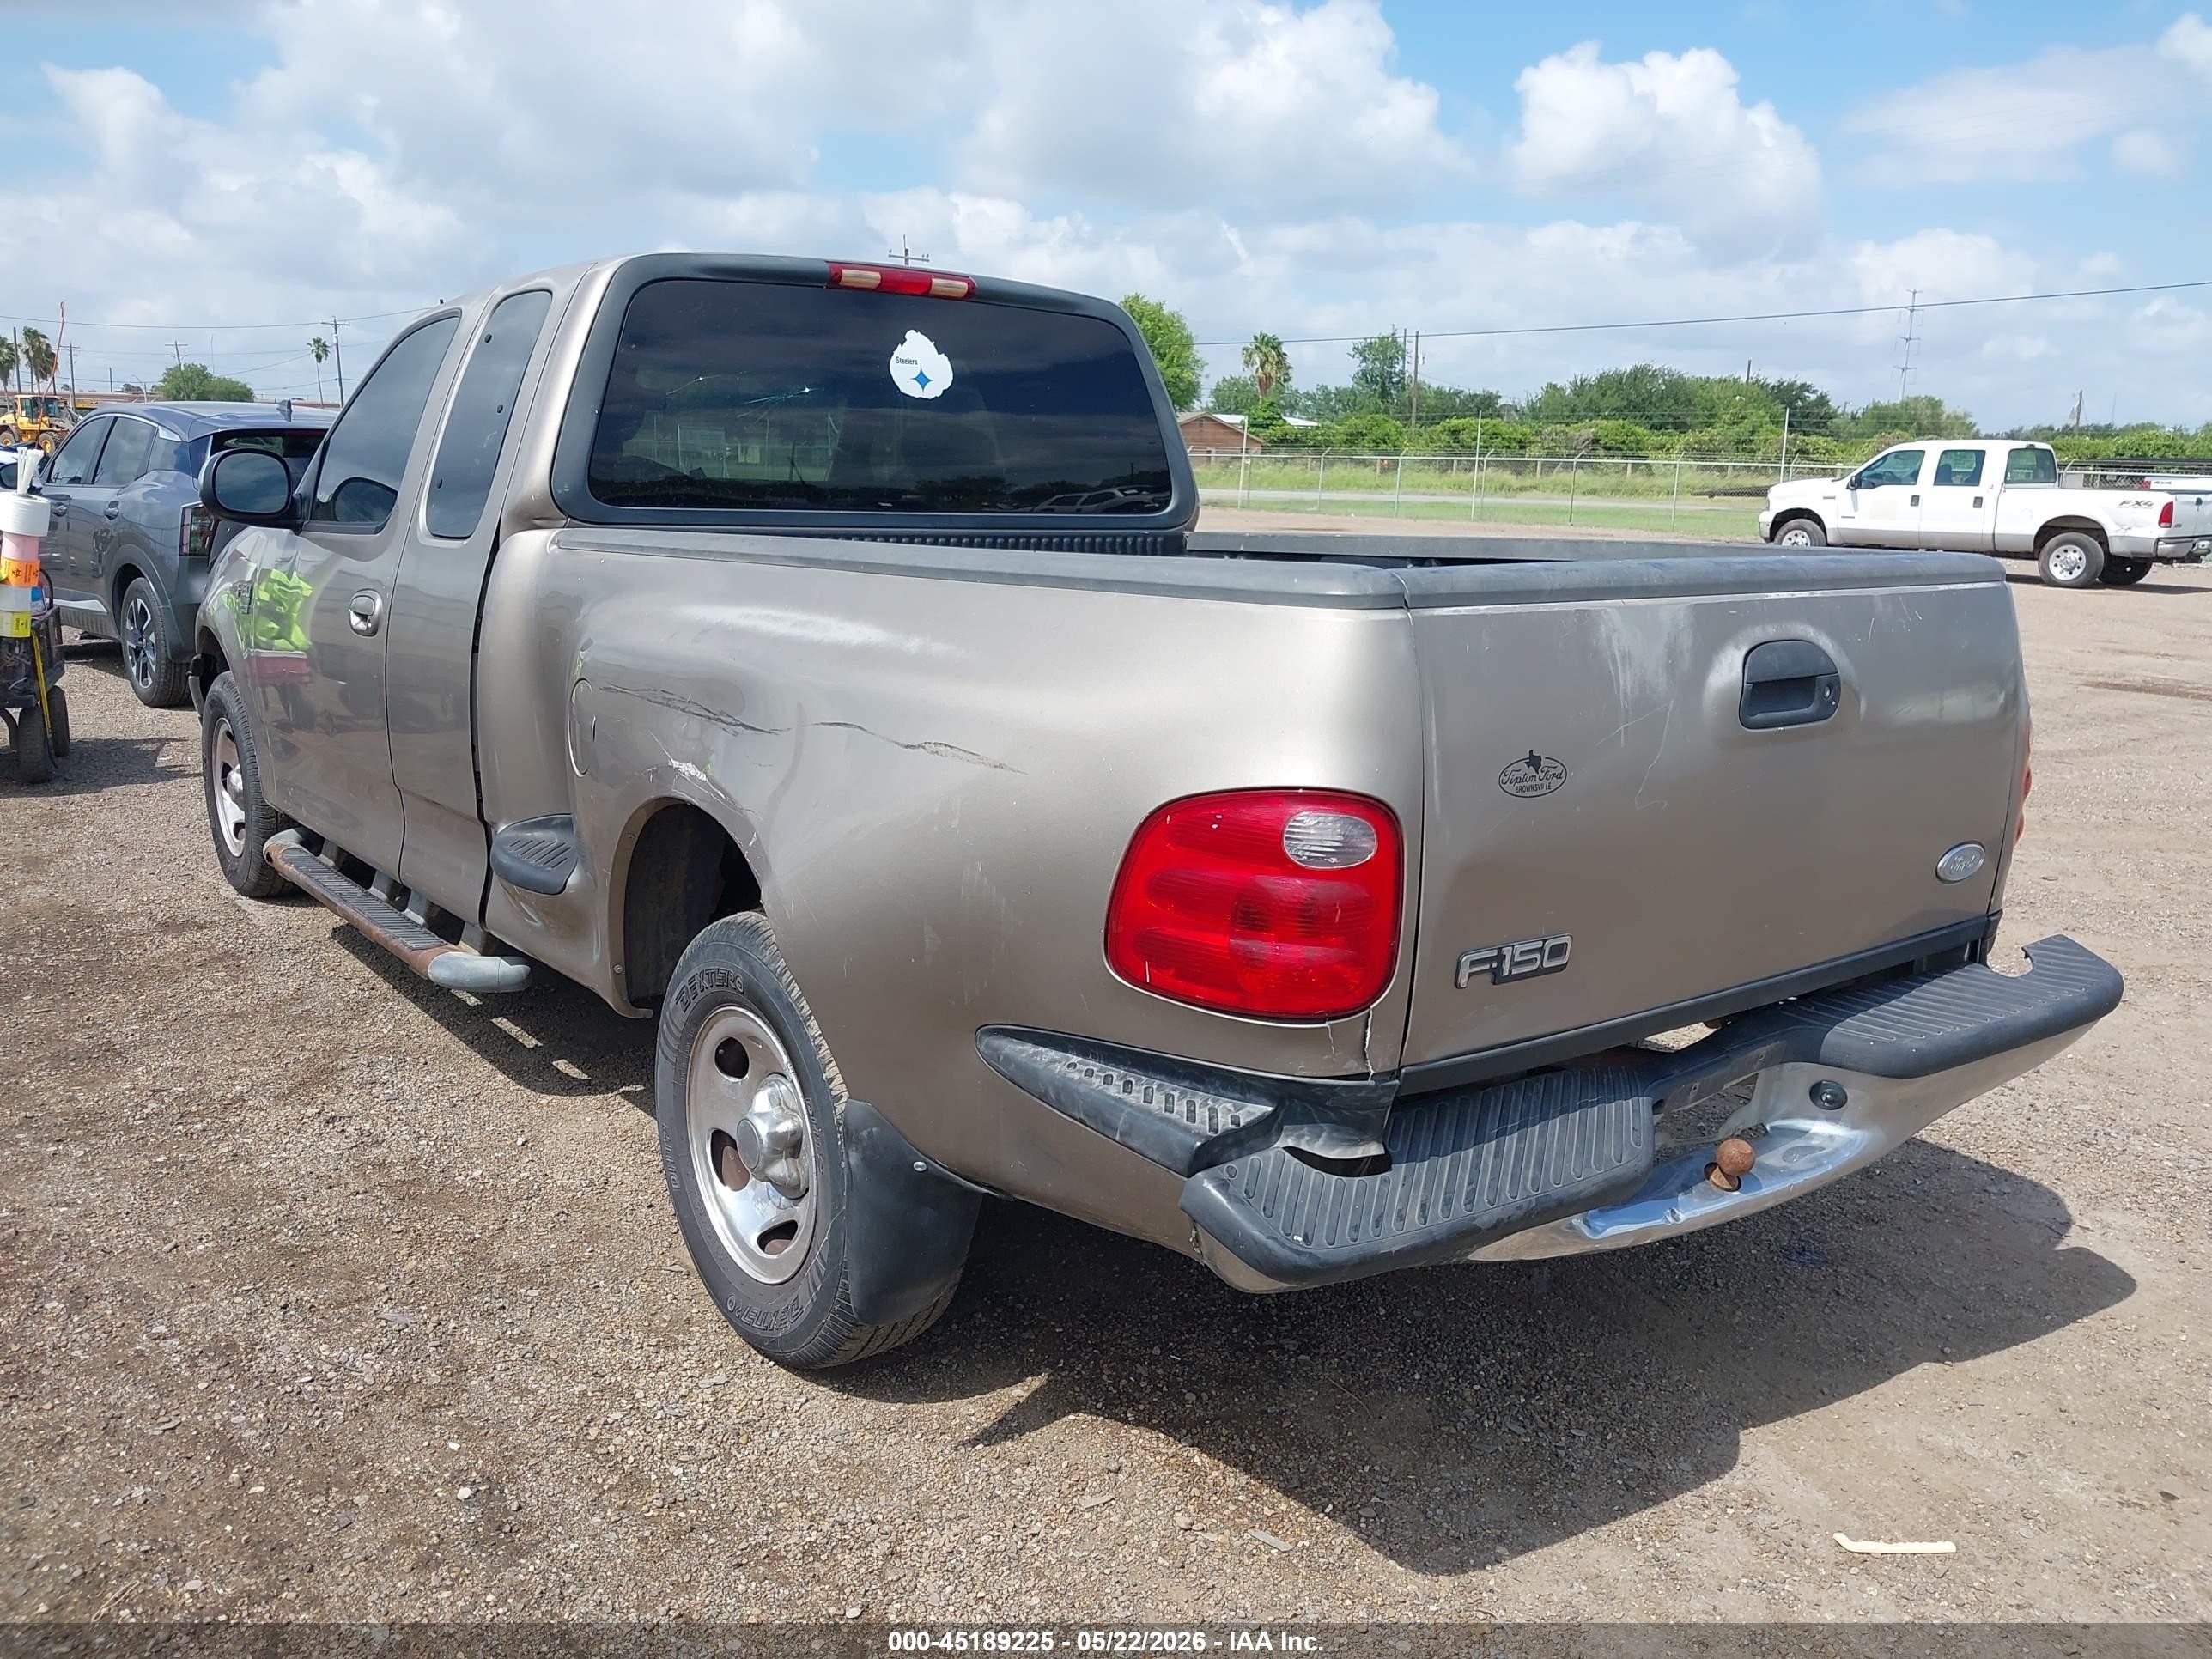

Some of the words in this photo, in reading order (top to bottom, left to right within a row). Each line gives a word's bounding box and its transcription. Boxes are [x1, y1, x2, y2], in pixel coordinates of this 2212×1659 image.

[895, 356, 918, 365] Steelers
[1501, 768, 1538, 787] Tipton
[1538, 765, 1565, 781] Ford
[675, 967, 744, 1013] DEXTERO
[726, 1294, 805, 1332] DEXTERO
